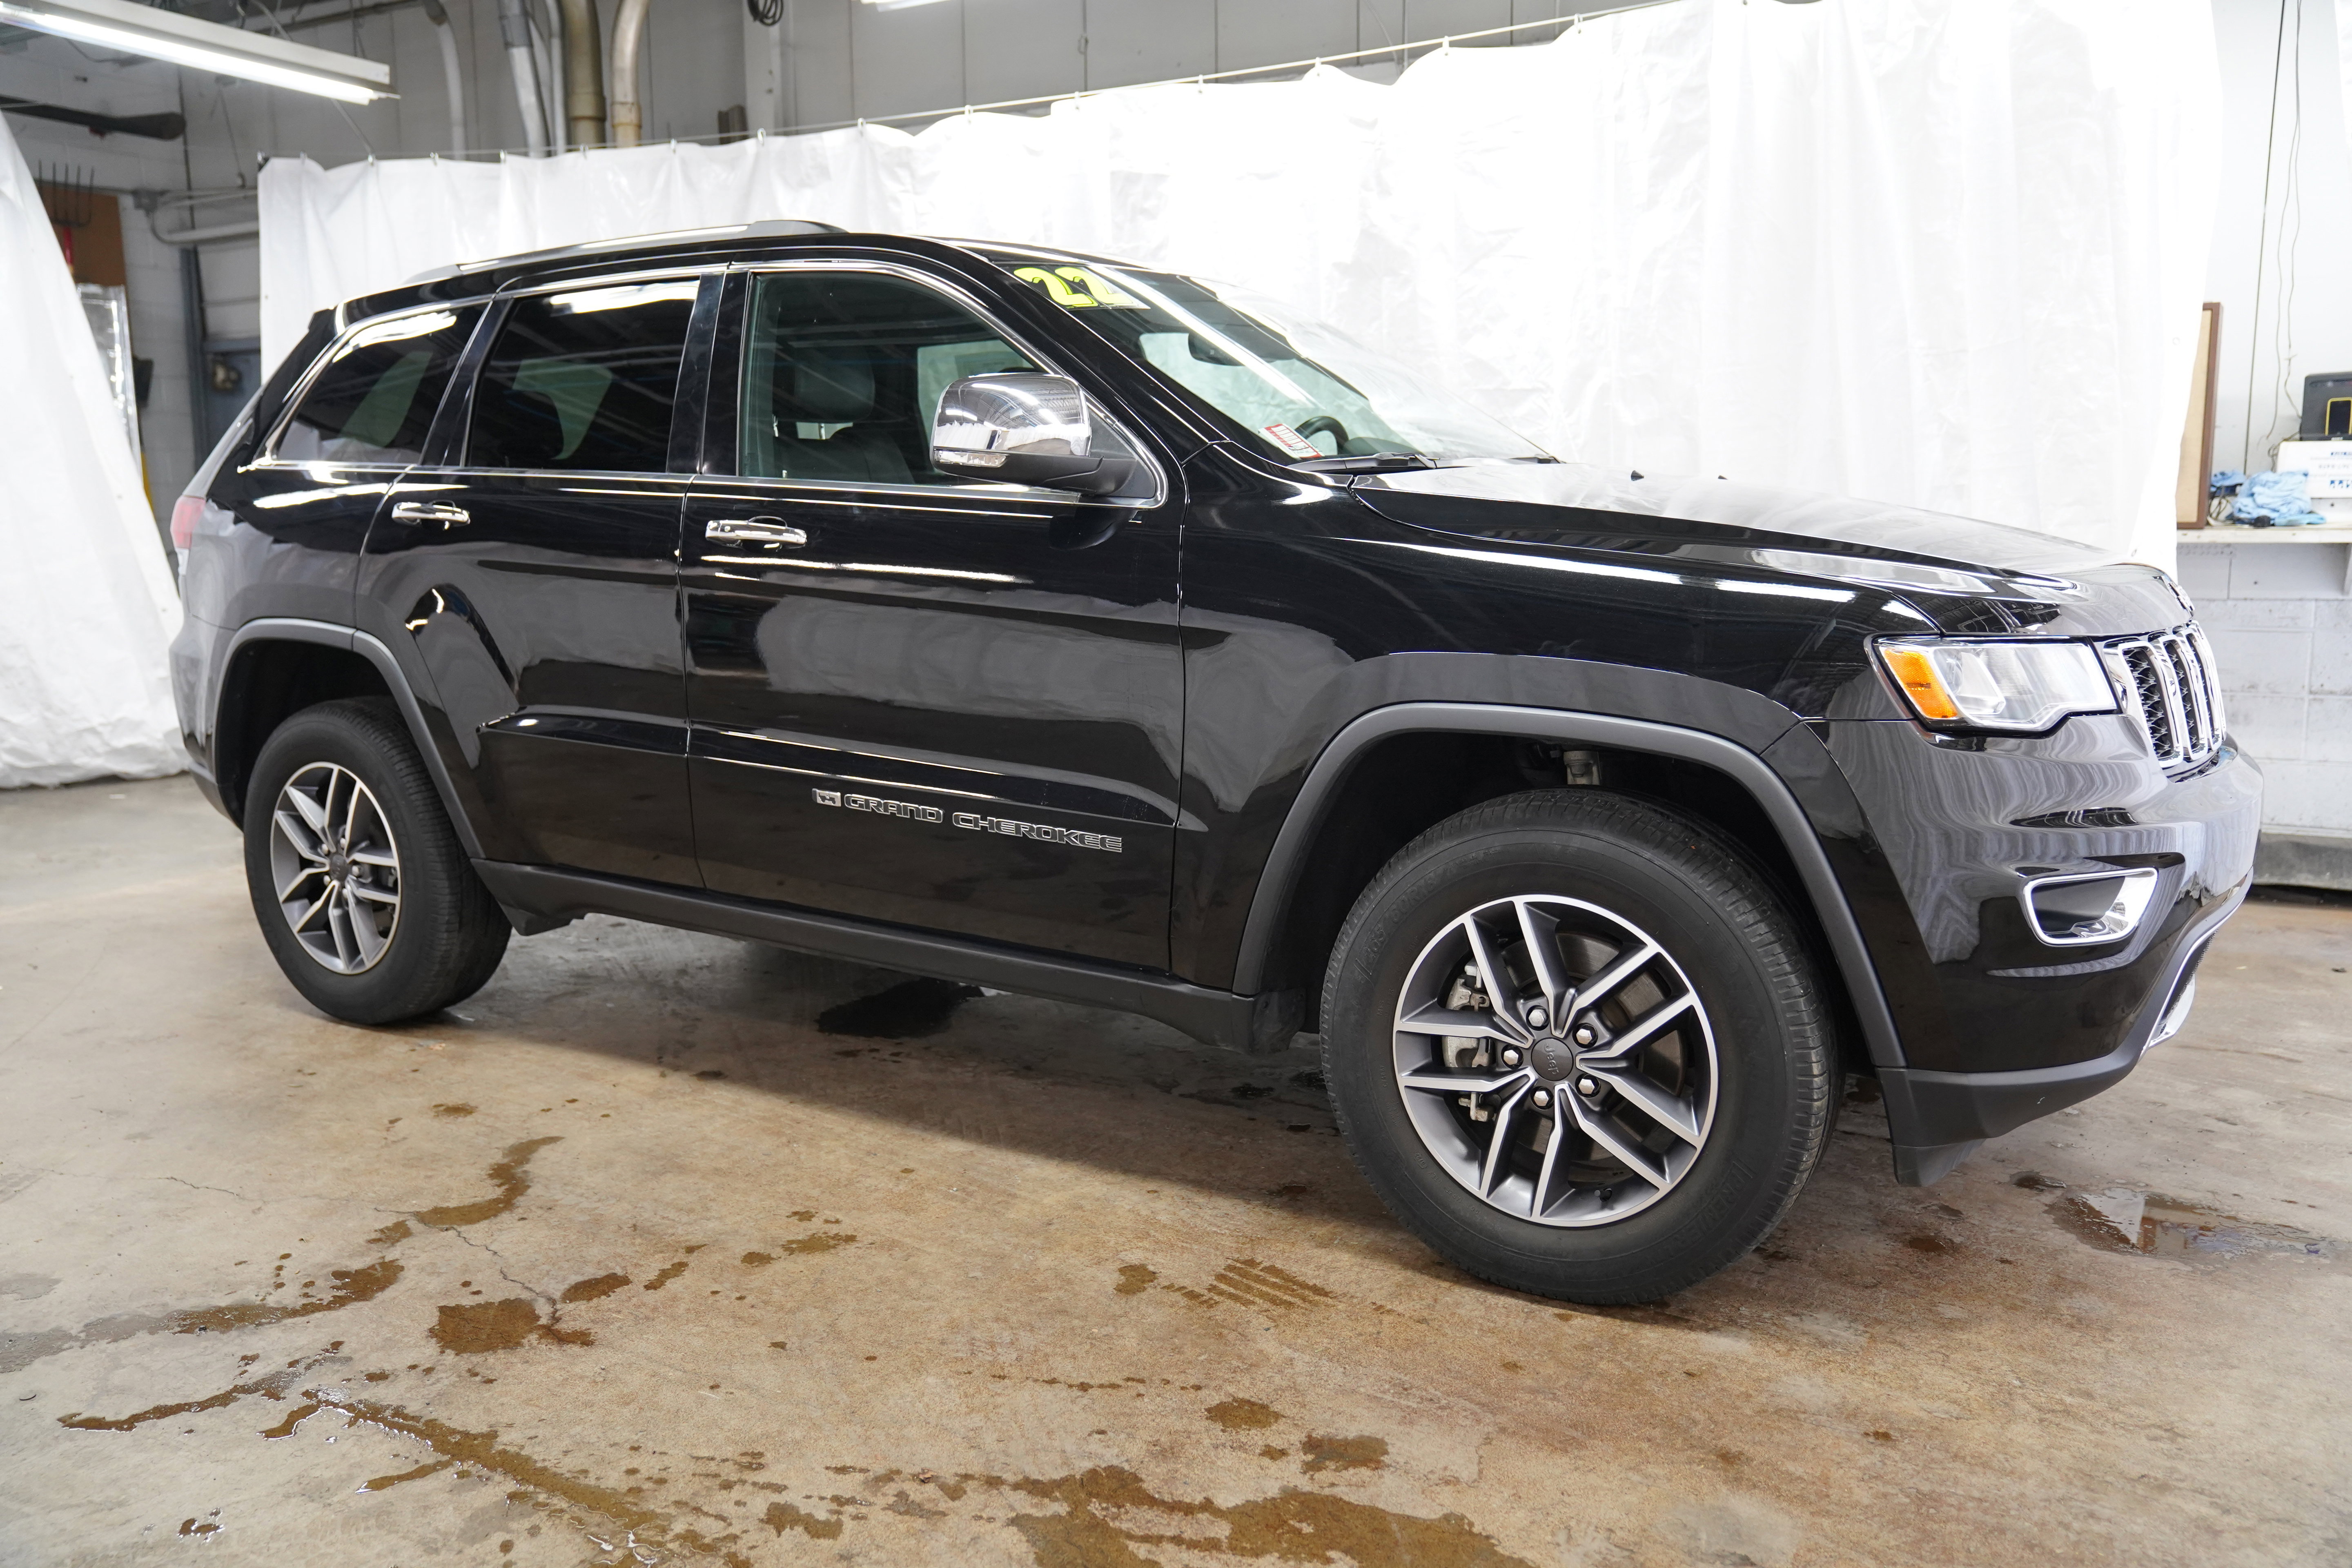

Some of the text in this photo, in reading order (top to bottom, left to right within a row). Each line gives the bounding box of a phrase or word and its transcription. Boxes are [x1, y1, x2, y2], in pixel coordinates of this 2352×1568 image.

[1014, 267, 1138, 307] 22
[845, 794, 1123, 853] GRAND CHEROKEE
[1545, 1044, 1559, 1074] Jeep
